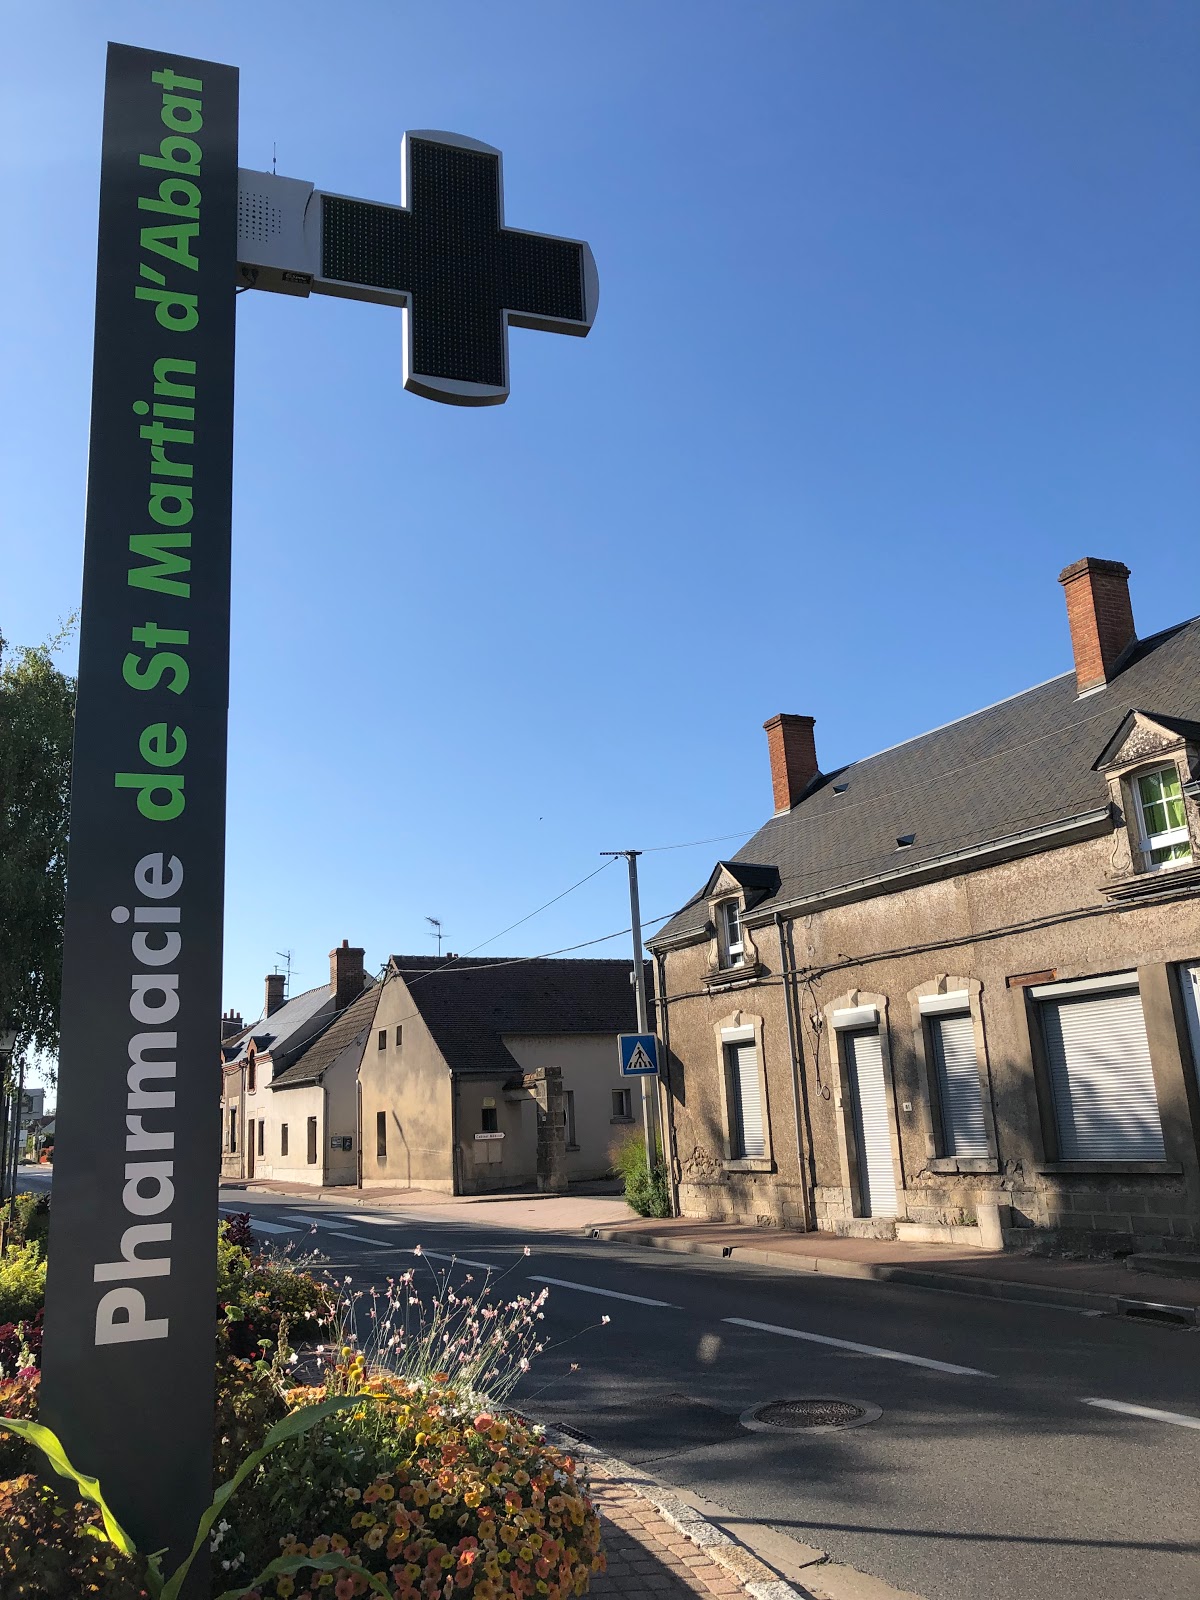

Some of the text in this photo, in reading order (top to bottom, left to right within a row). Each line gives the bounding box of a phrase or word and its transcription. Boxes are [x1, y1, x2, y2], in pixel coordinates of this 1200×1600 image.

[128, 358, 198, 598] Martin
[123, 622, 189, 694] St
[115, 723, 188, 821] de
[94, 853, 184, 1345] Pharmacie
